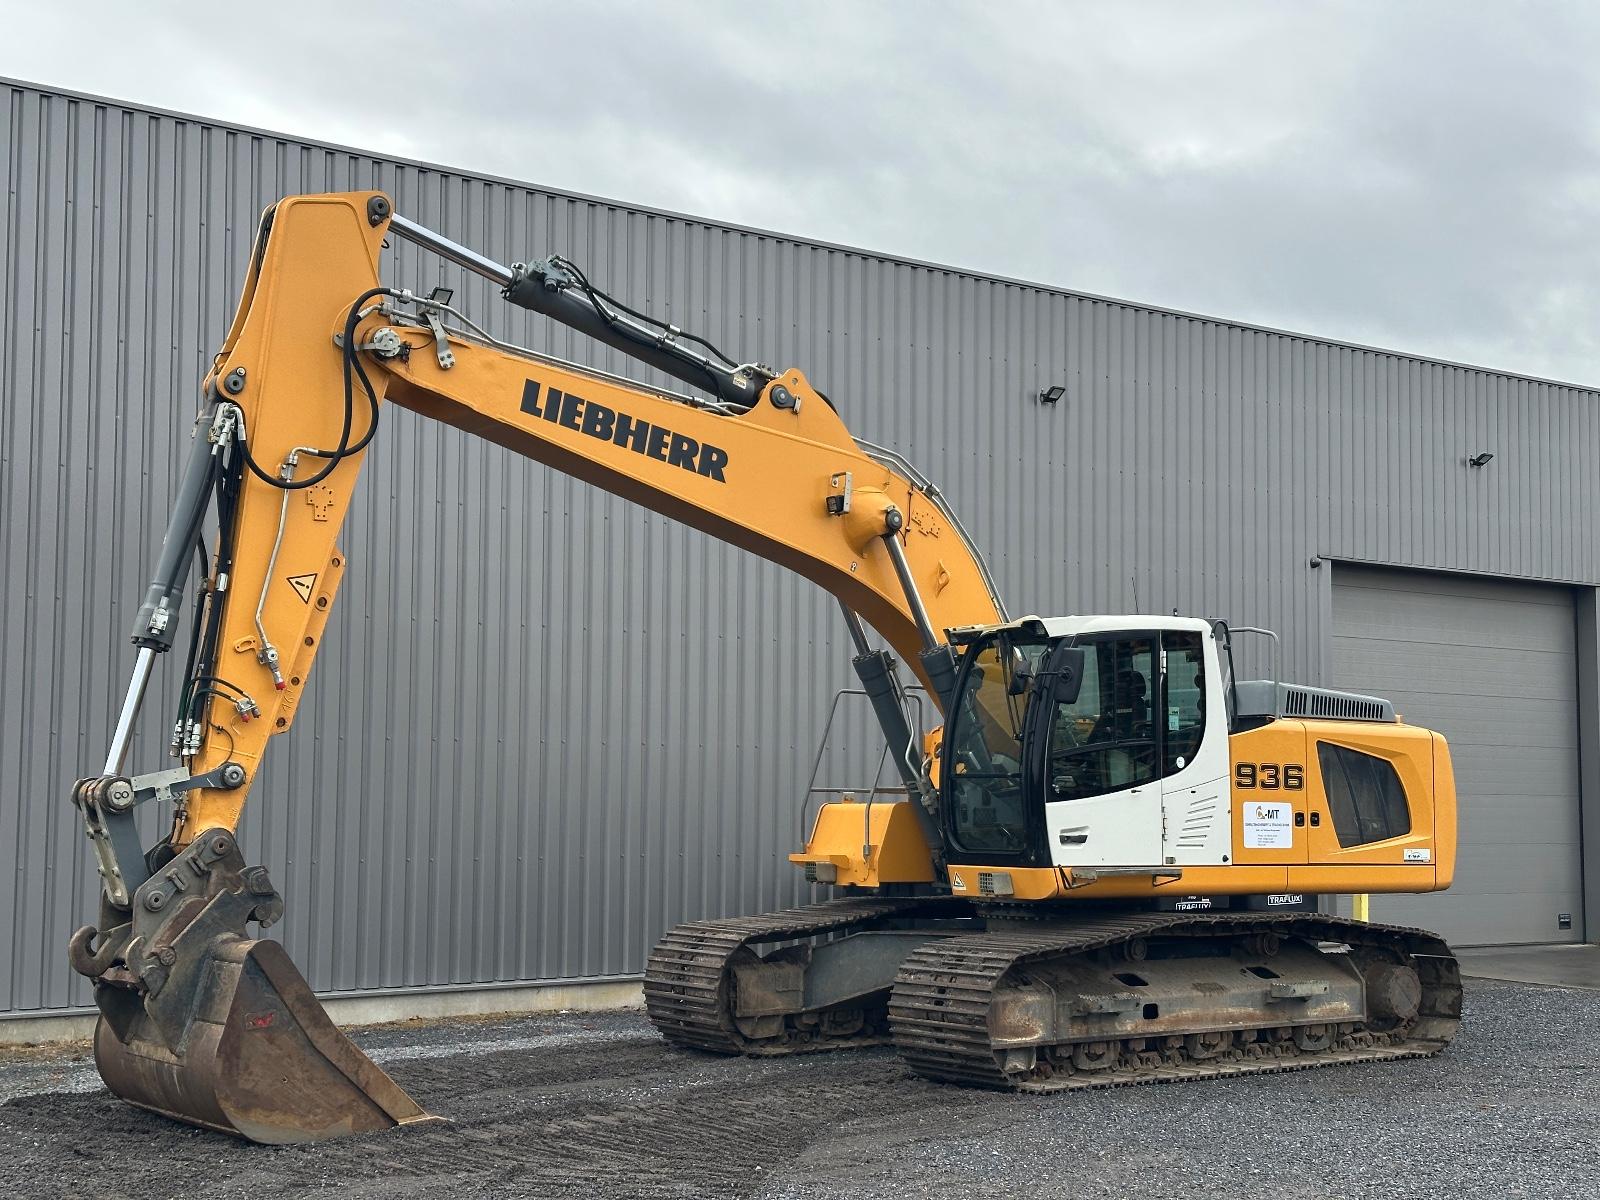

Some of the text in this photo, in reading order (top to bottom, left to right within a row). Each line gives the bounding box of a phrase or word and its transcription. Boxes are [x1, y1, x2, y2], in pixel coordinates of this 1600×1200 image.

[520, 378, 729, 484] LIEBHERR
[1235, 762, 1304, 791] 936
[1269, 895, 1301, 904] TRAFLUX
